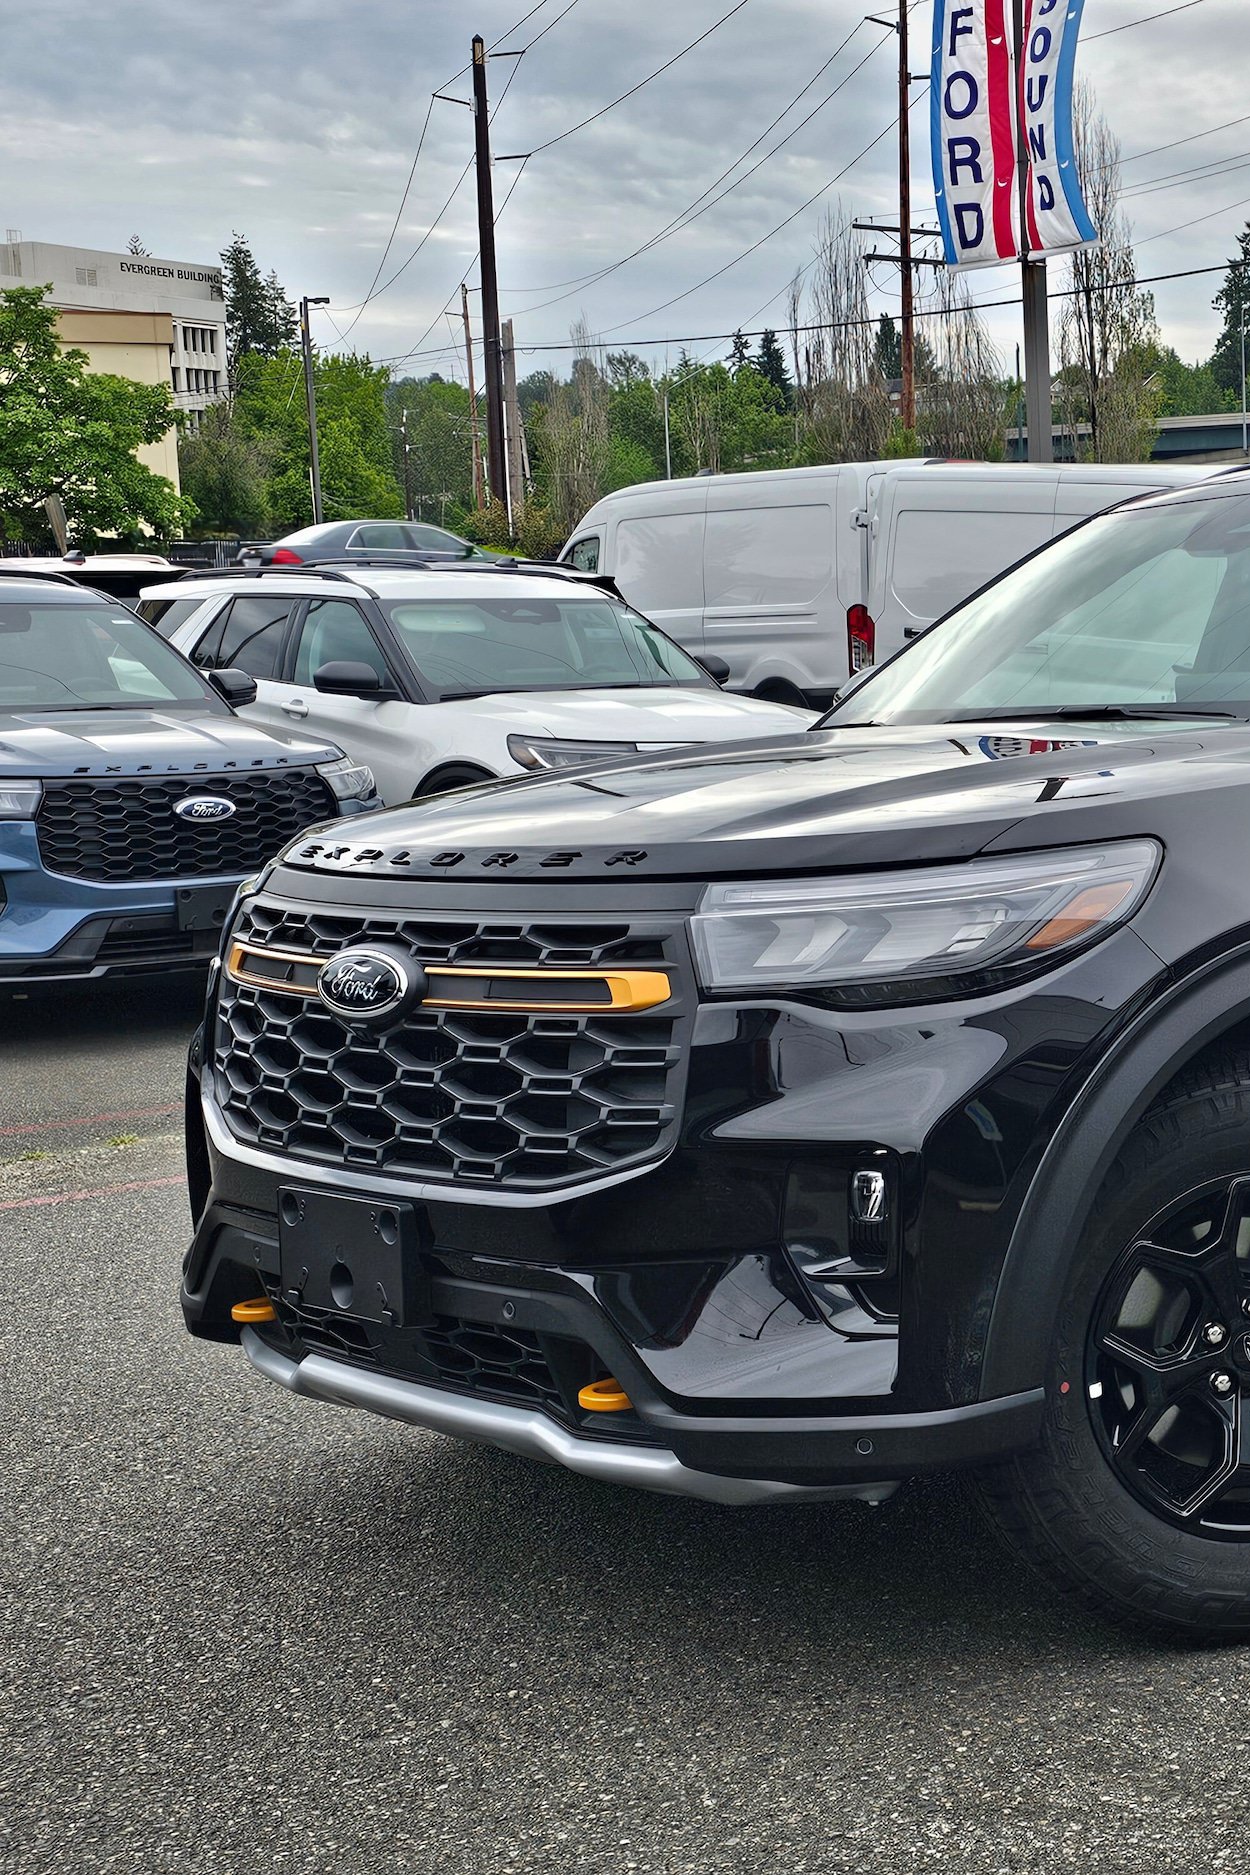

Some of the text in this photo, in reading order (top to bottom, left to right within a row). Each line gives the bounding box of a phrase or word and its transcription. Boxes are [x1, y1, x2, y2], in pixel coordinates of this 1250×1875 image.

[944, 6, 984, 250] FORD
[120, 262, 220, 284] EVERGREEN BUILDING
[73, 758, 288, 774] EXPLORER
[191, 801, 222, 816] Ford
[299, 845, 649, 868] EXPLORER
[331, 963, 381, 1000] Ford
